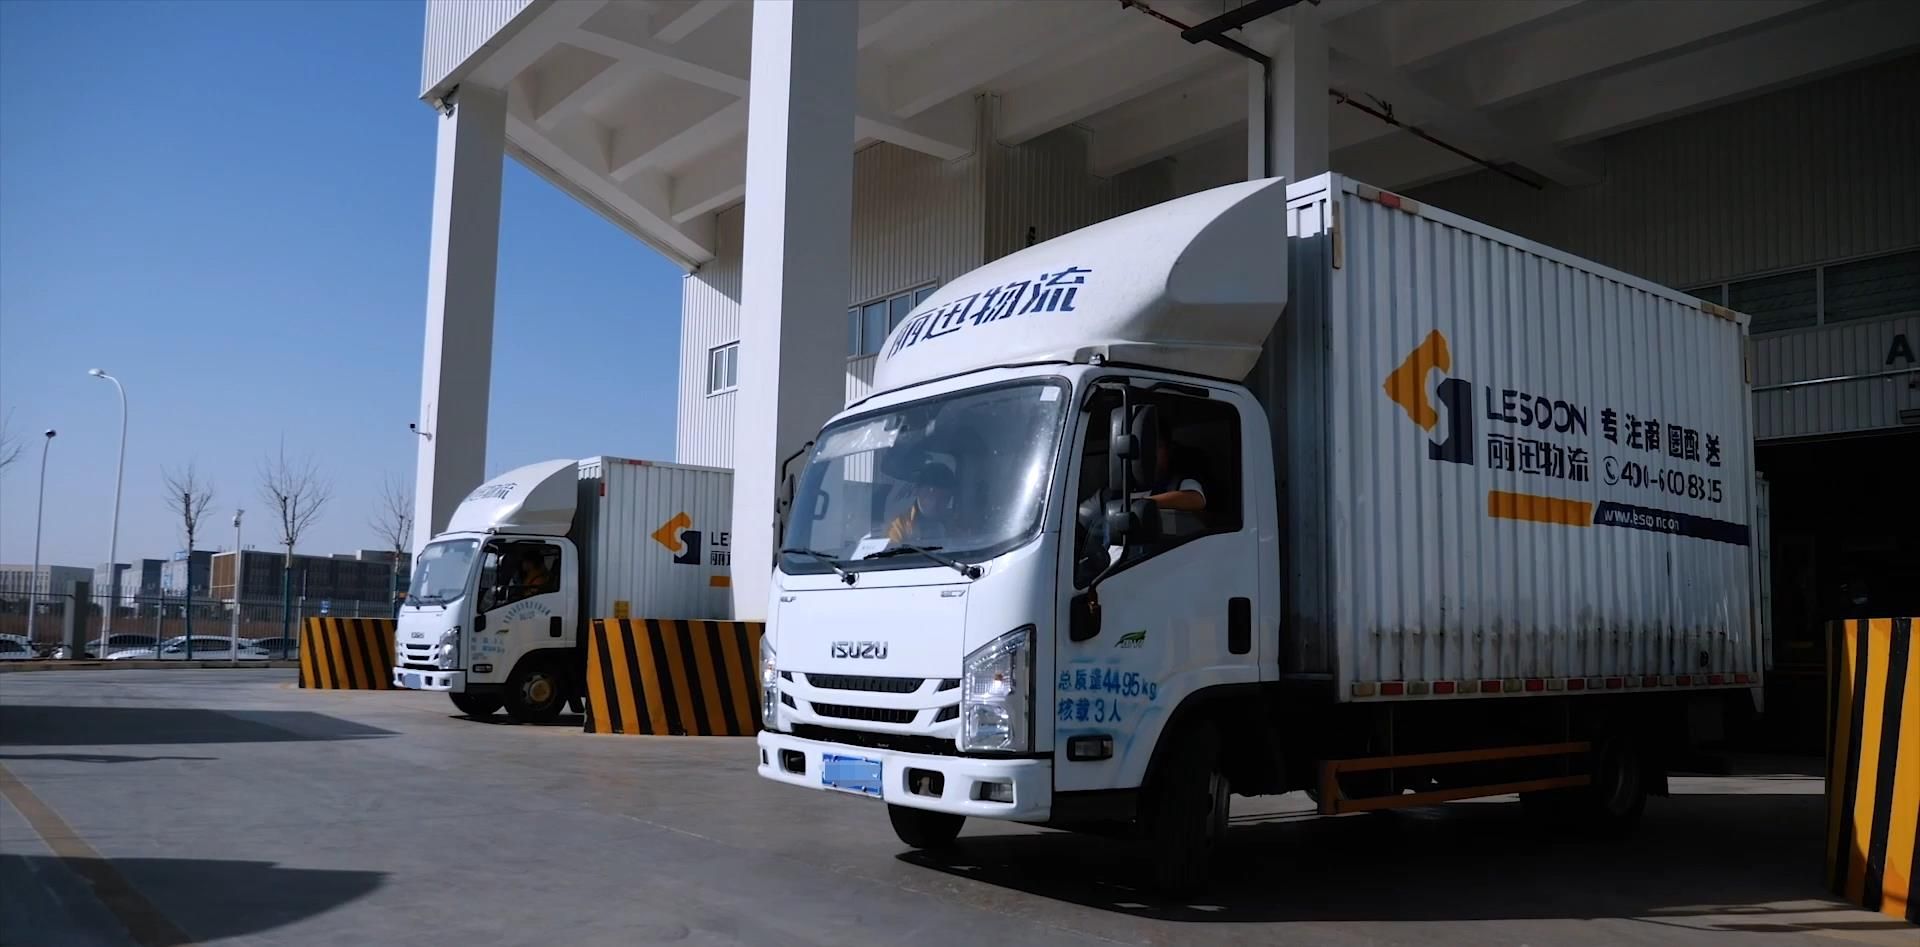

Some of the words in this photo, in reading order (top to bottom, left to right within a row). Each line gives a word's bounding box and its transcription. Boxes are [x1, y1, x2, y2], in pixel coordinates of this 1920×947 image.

[887, 266, 1092, 360] 丽迅物流
[1885, 334, 1916, 365] A
[1486, 386, 1588, 436] LESOON
[1488, 433, 1589, 481] 丽迅物流
[711, 531, 731, 546] LE
[831, 641, 888, 659] ISUZU
